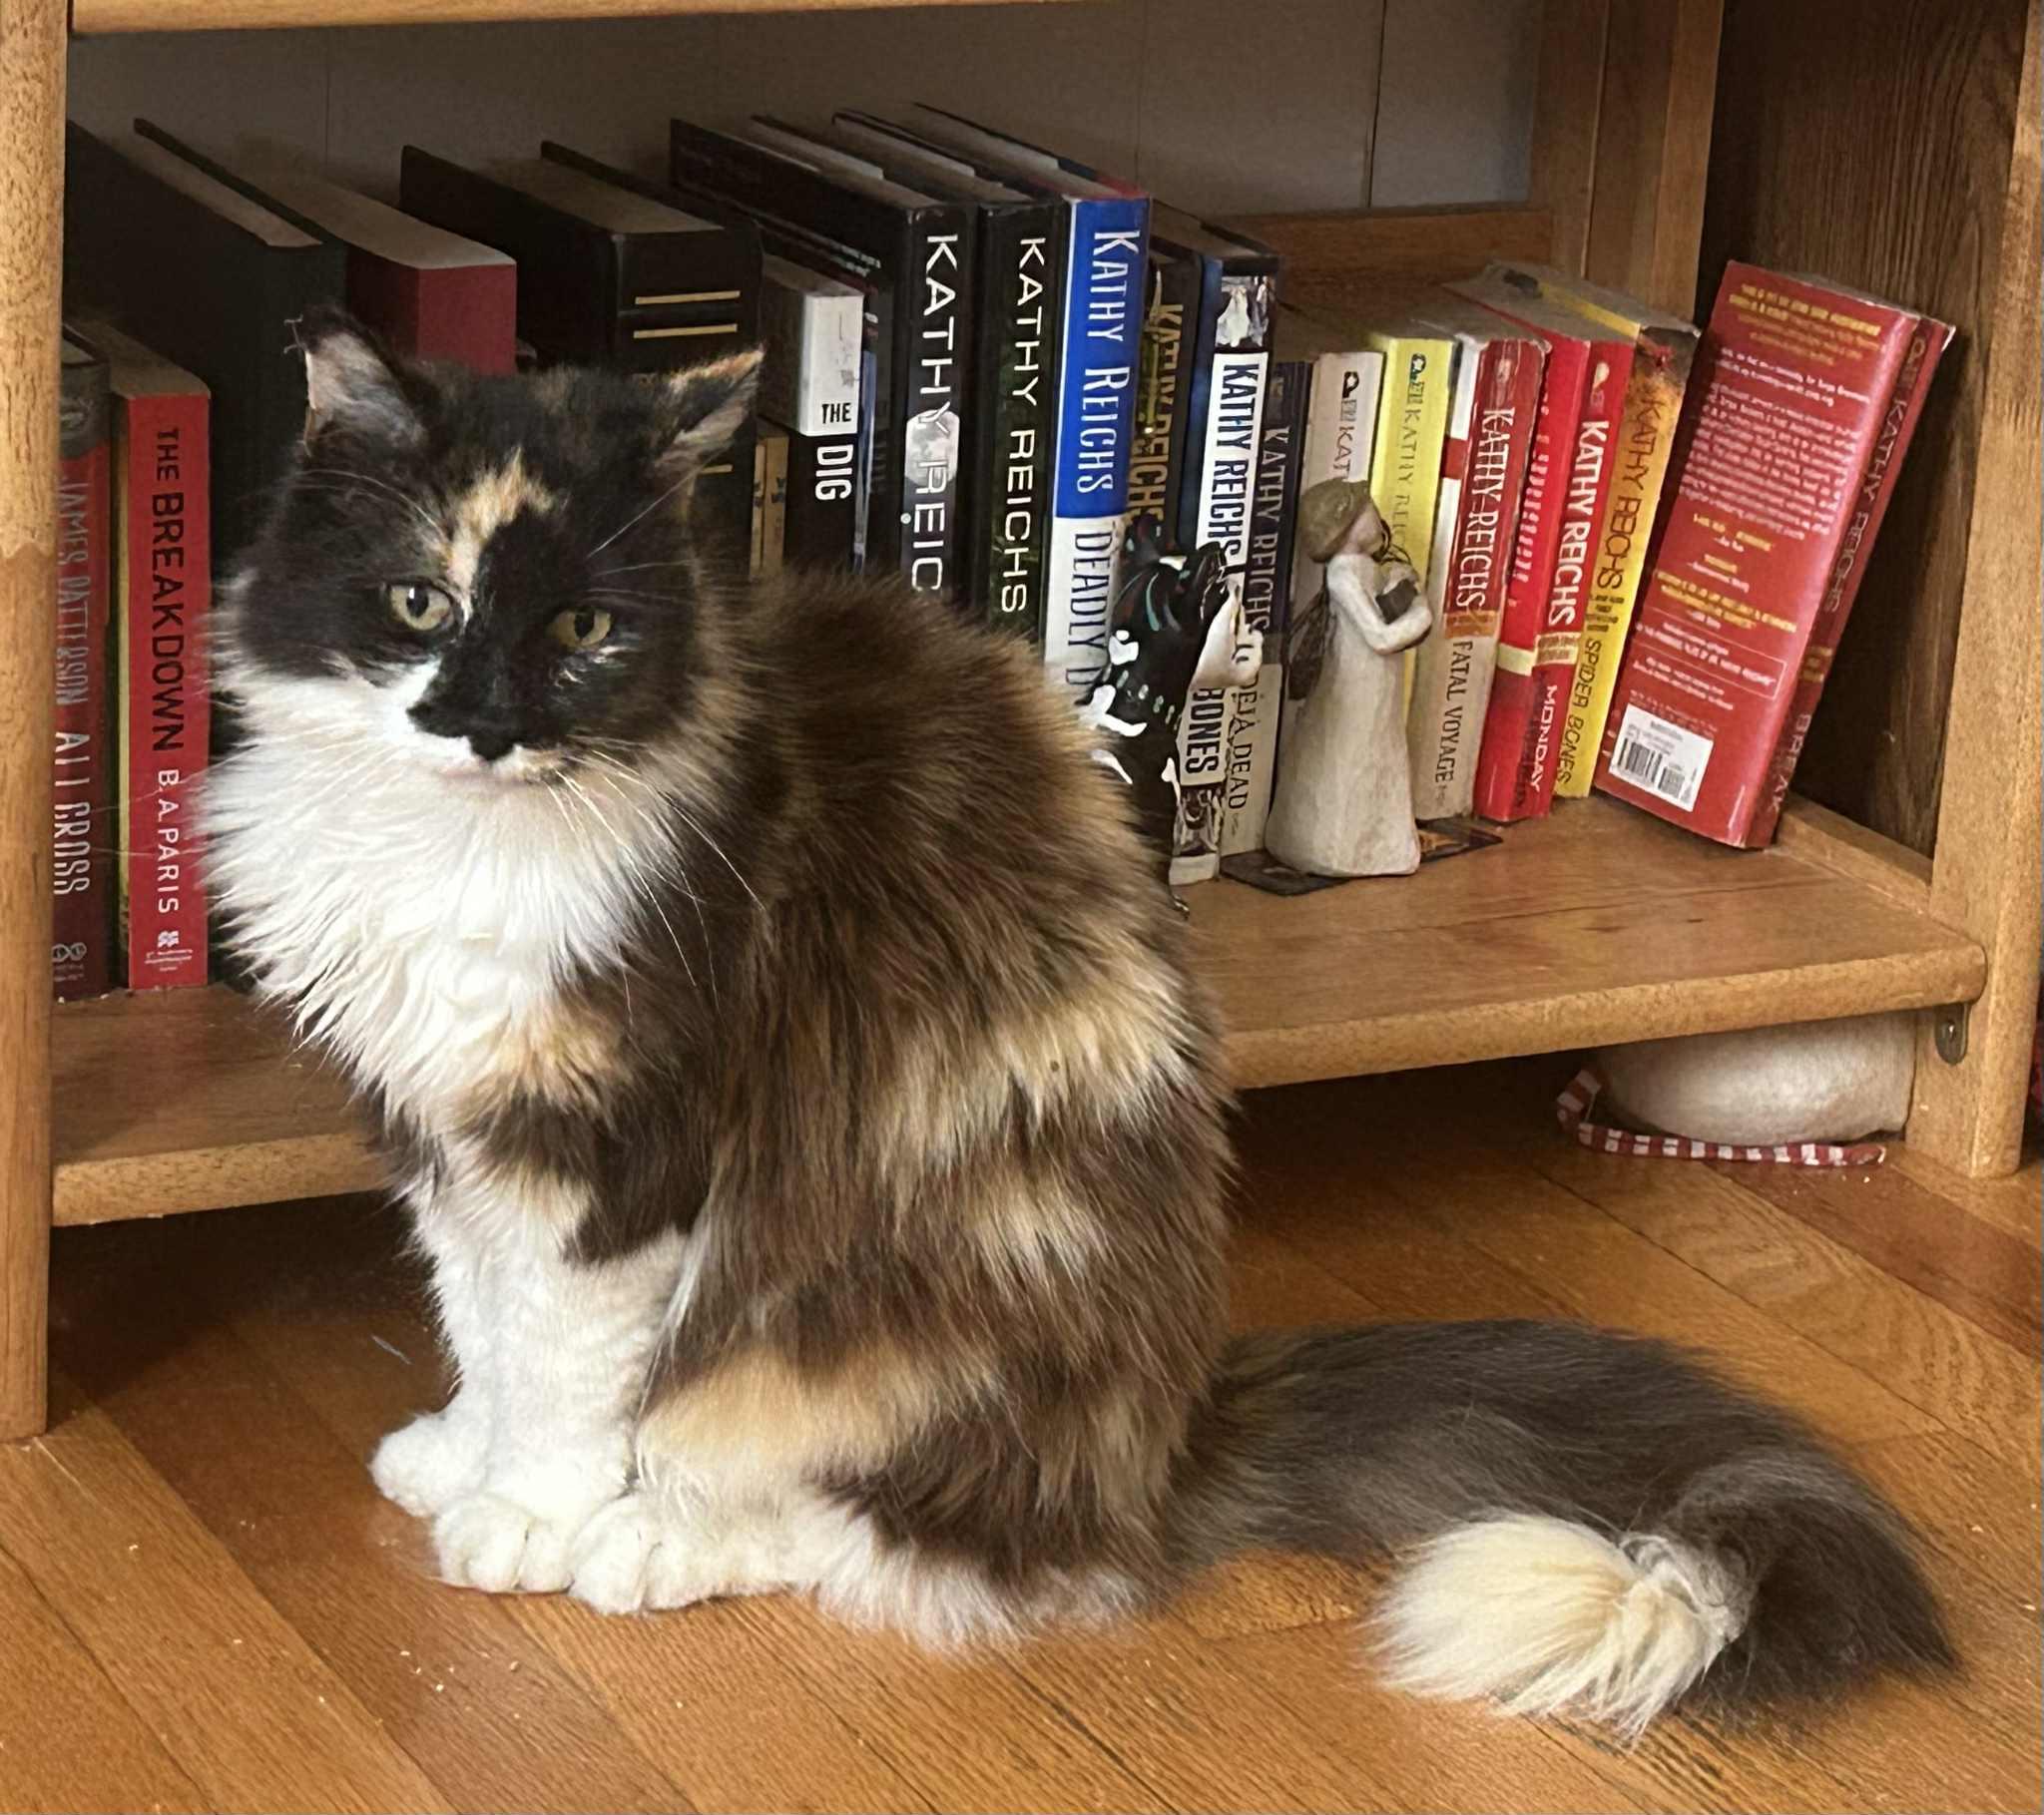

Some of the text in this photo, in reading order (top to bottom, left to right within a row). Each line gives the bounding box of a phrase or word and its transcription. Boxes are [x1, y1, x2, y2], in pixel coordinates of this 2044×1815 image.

[916, 233, 958, 434] KATHY
[1077, 229, 1141, 494] KATHY REICHS
[821, 402, 851, 424] THE
[1001, 237, 1046, 614] KATHY REICHS
[1208, 363, 1260, 558] KATHY REICHS
[1397, 408, 1422, 483] KATHY
[1471, 405, 1515, 502] KATHY
[1622, 398, 1666, 491] KATHY
[815, 444, 854, 500] DIG
[1567, 420, 1610, 517] KATHY
[1824, 398, 1907, 613] KATHY REICHS
[1246, 426, 1290, 634] KATHY REICHS
[1455, 509, 1500, 610] REICHS
[1548, 521, 1591, 628] REICHS
[1597, 495, 1642, 591] REICHS
[152, 427, 185, 751] THE BREAKDOWN
[1068, 532, 1113, 650] DEADLY
[1446, 640, 1473, 701] FATAL
[1557, 639, 1602, 784] SPIDER BONES
[1228, 742, 1253, 810] DEAD
[1435, 705, 1463, 783] VOYAGE
[1530, 683, 1558, 792] MONDAY
[53, 801, 92, 895] CROSS
[157, 827, 181, 914] PARIS
